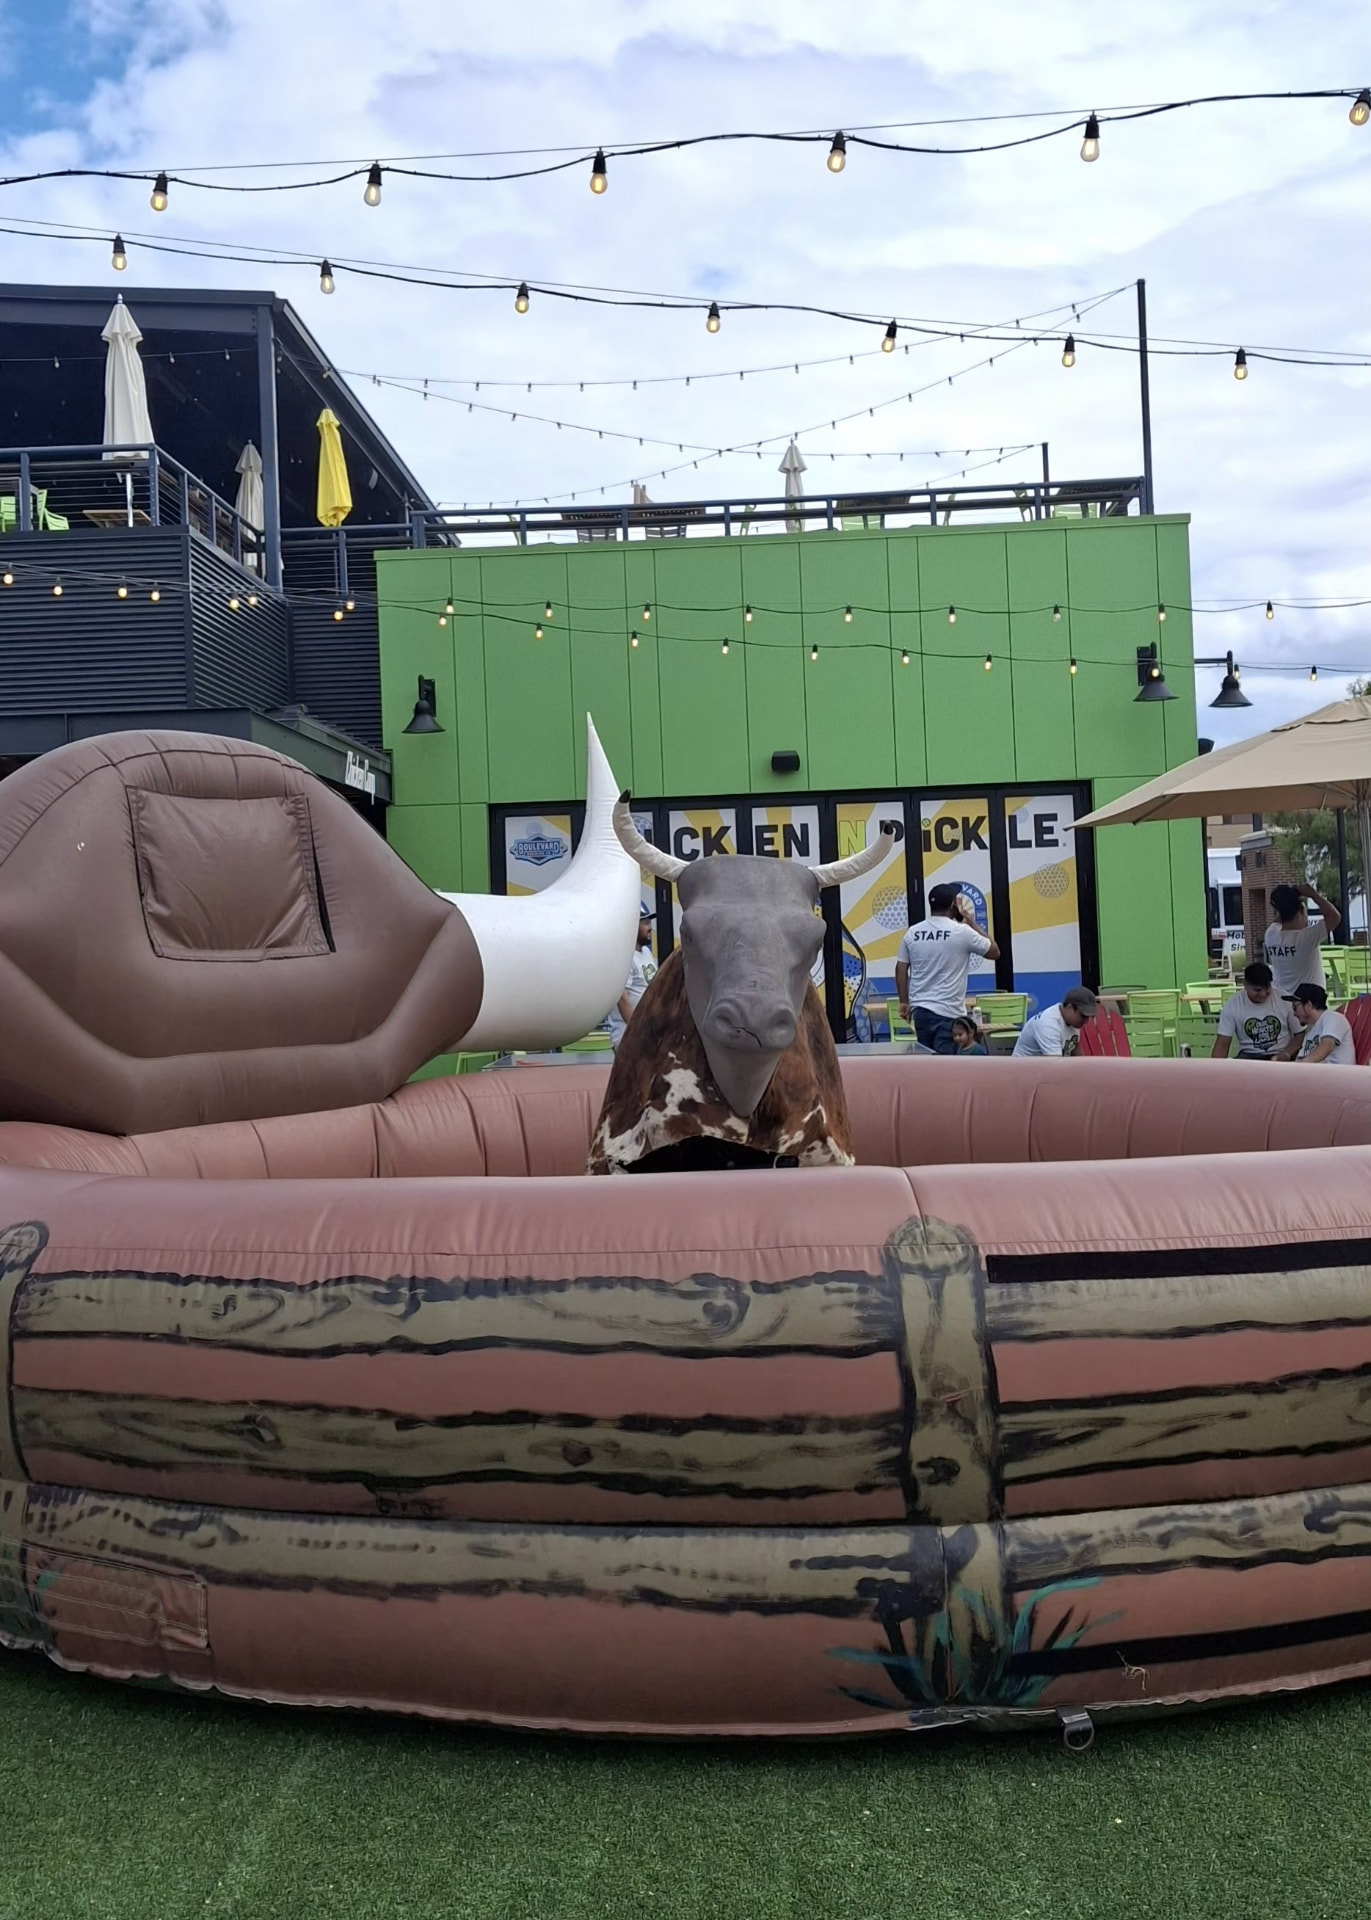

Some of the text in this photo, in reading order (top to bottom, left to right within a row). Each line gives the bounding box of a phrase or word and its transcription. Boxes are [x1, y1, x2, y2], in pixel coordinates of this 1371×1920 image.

[838, 820, 866, 857] N
[518, 842, 559, 855] BOULEVARD
[914, 930, 951, 942] STAFF
